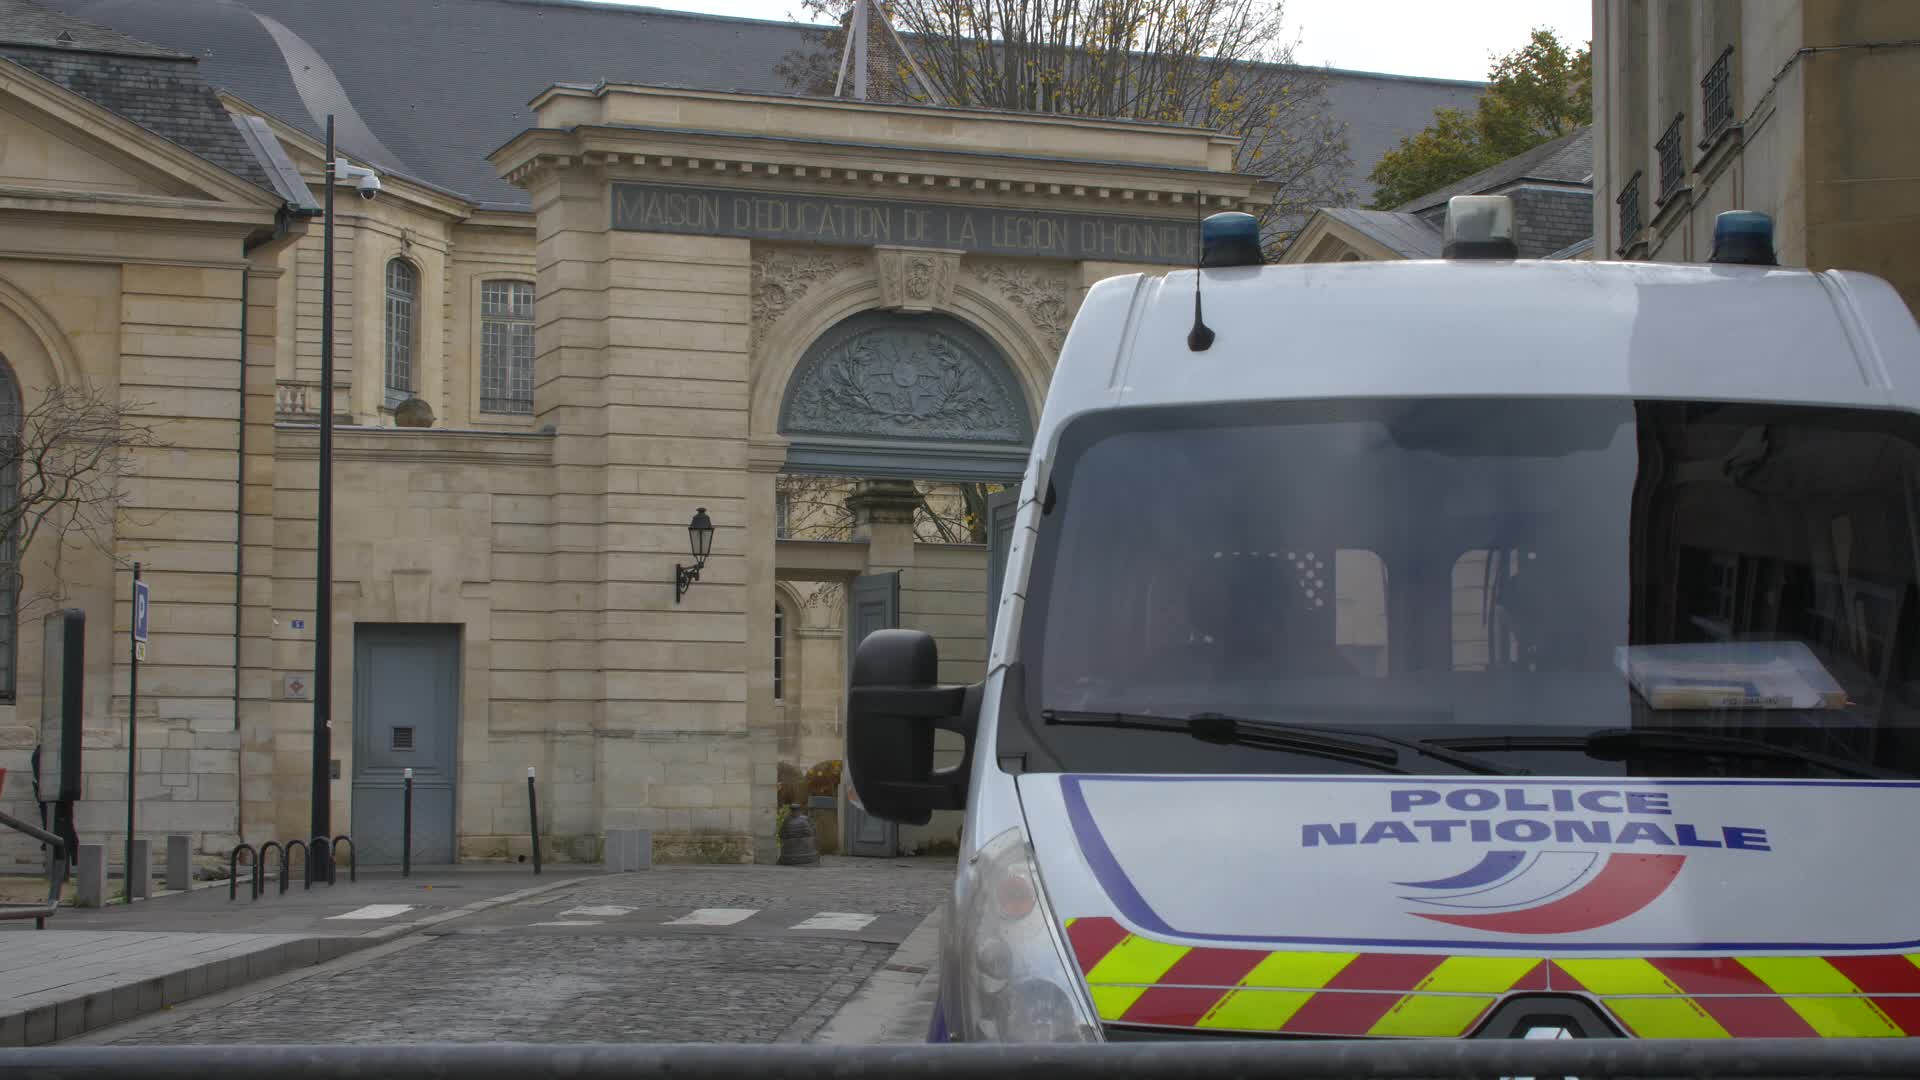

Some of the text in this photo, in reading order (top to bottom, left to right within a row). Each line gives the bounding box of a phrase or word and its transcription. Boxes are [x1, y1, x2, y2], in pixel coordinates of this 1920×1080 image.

[616, 190, 720, 230] MAISON
[903, 208, 931, 241] DE
[946, 211, 976, 248] LA
[138, 594, 145, 629] P
[1390, 788, 1673, 815] POLICE
[1301, 818, 1773, 852] NATIONALE
